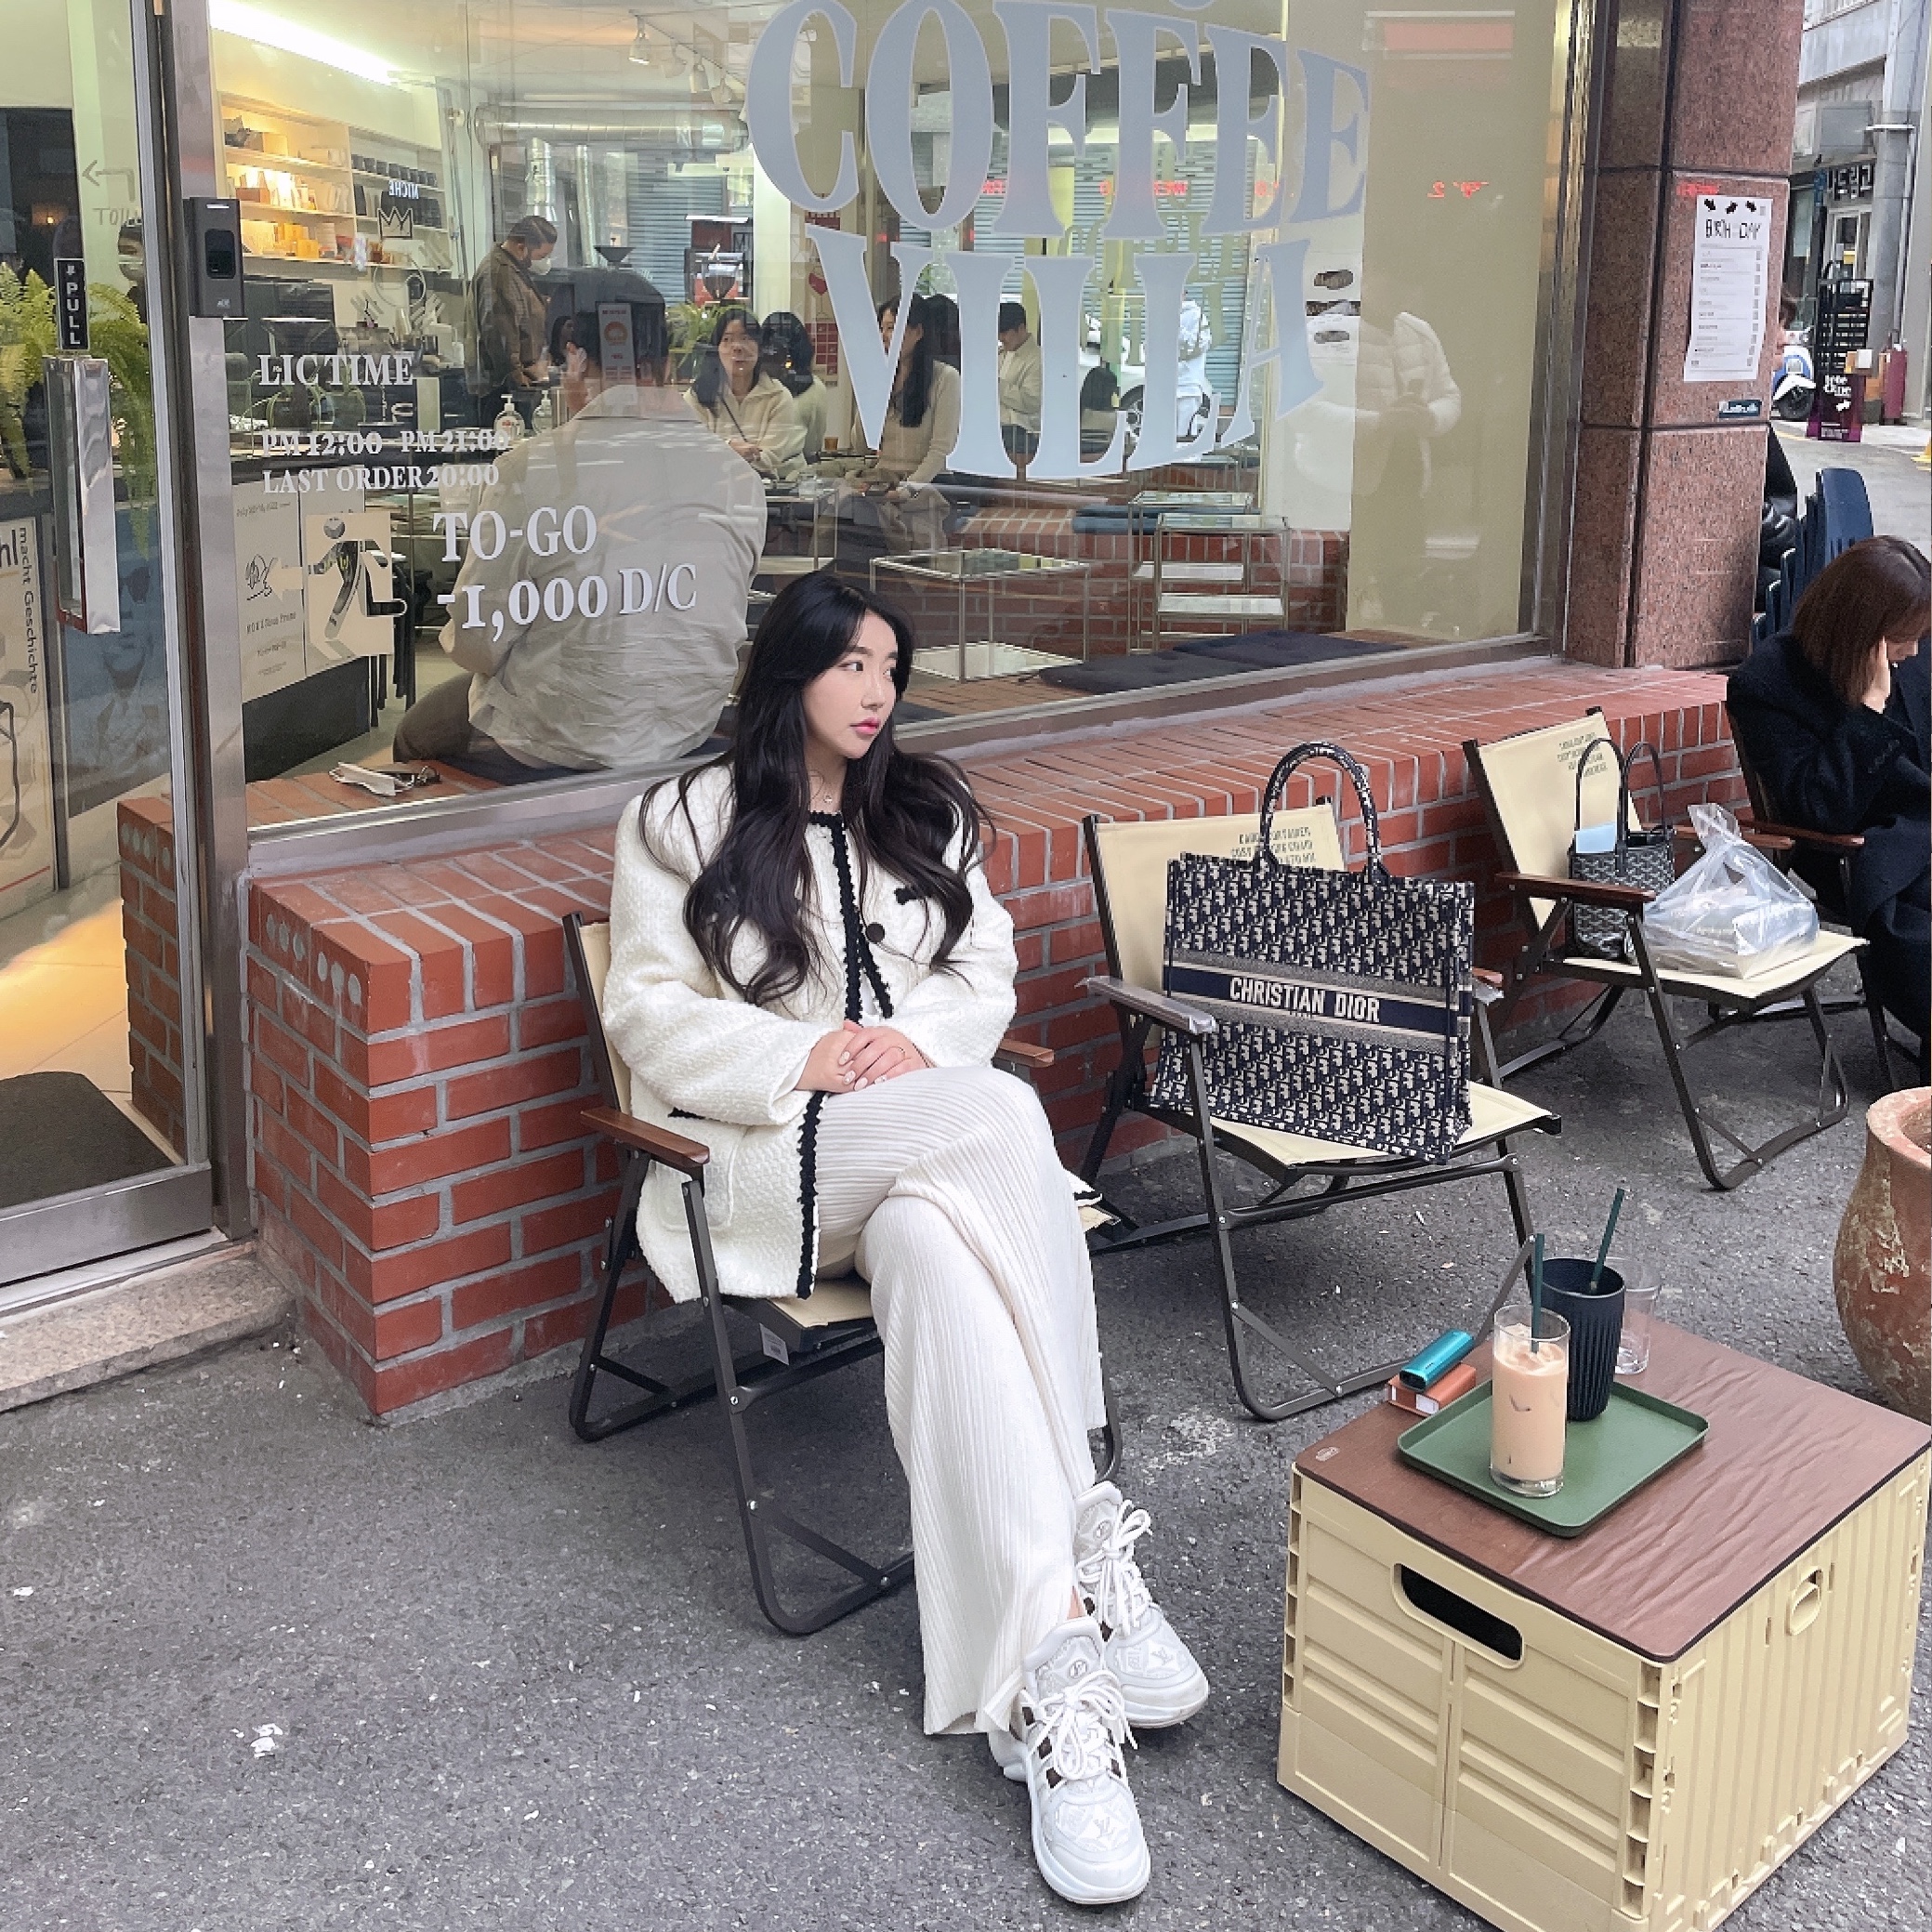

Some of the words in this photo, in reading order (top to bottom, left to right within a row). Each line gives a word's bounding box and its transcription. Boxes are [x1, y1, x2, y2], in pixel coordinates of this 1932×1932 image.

[746, 0, 1371, 241] COFFEE
[66, 283, 81, 345] PULL
[806, 223, 1325, 480] VILLA
[262, 469, 328, 493] LAST
[335, 466, 422, 493] ORDER
[20, 527, 33, 586] macht
[432, 505, 598, 562] TO-GO
[618, 563, 697, 615] D/C
[24, 590, 39, 695] Geschichte
[1229, 977, 1326, 1014] CHRISTIAN
[1334, 993, 1380, 1022] DIOR
